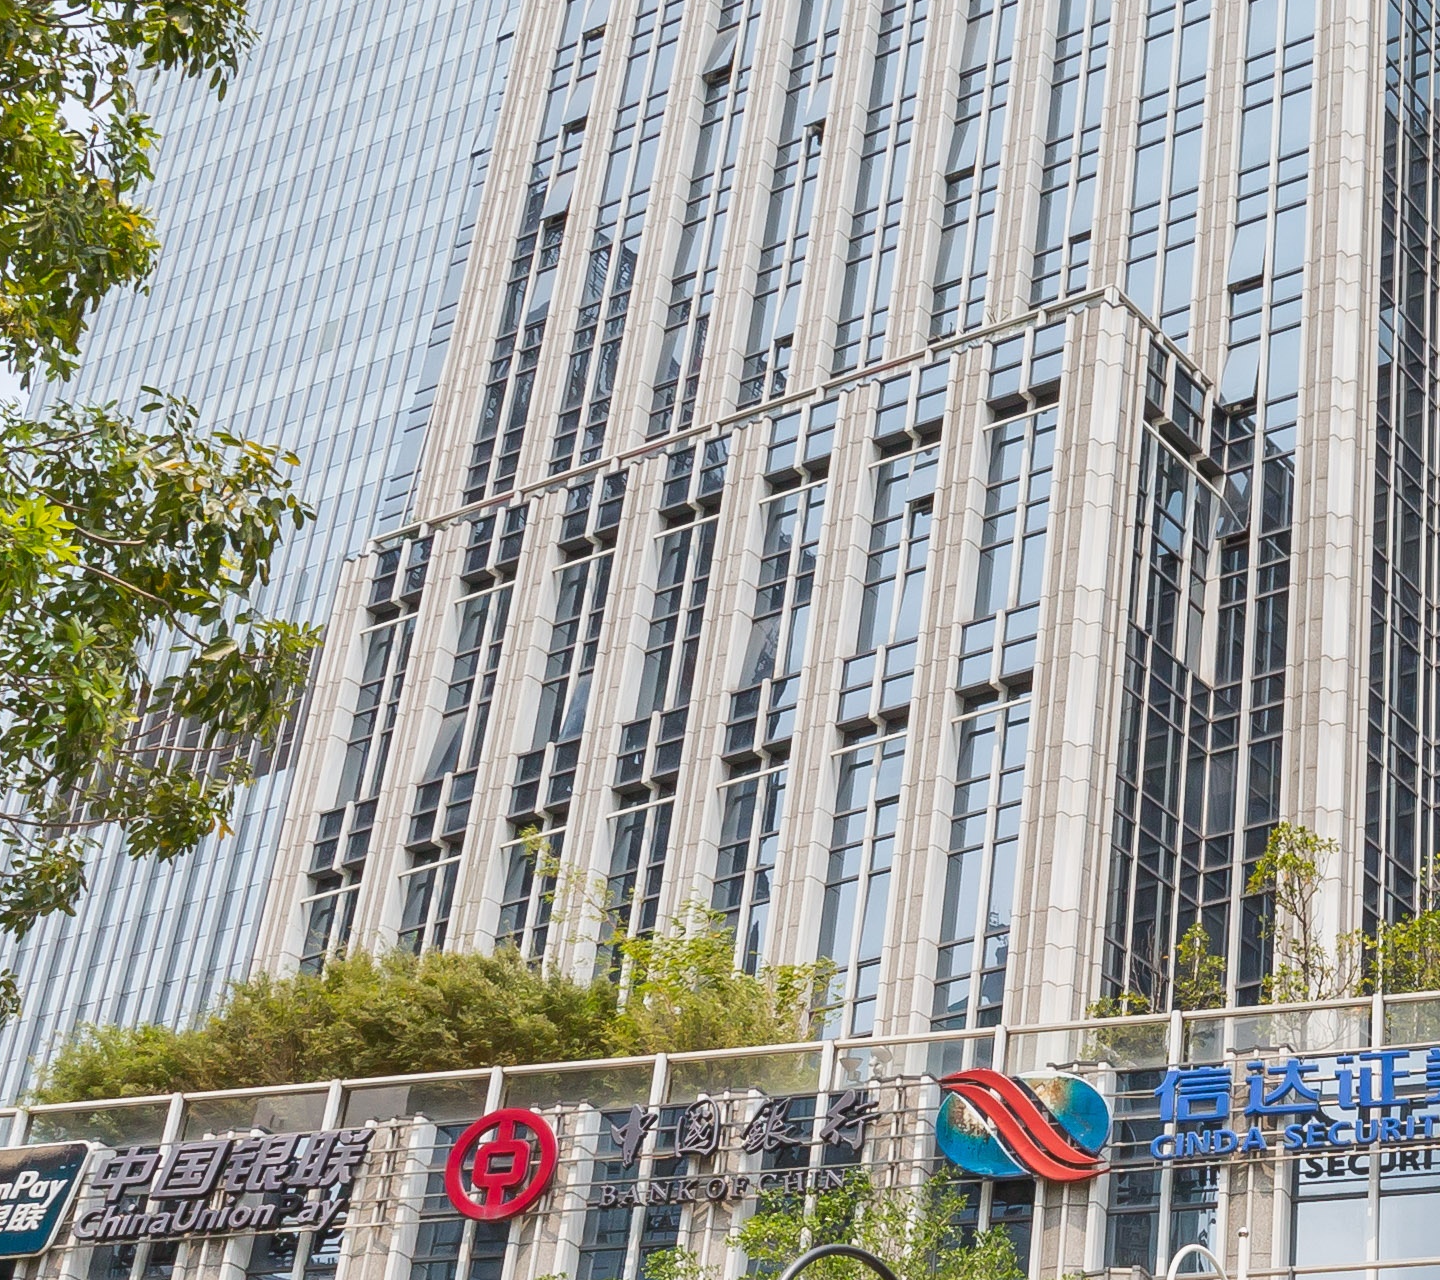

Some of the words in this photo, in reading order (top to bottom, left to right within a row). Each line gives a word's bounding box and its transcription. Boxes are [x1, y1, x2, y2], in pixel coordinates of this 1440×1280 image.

[1150, 1126, 1268, 1161] CINDA
[91, 1127, 376, 1202] 中国银联
[599, 1178, 698, 1208] BANK
[705, 1175, 751, 1202] OF
[757, 1168, 847, 1197] CHIN
